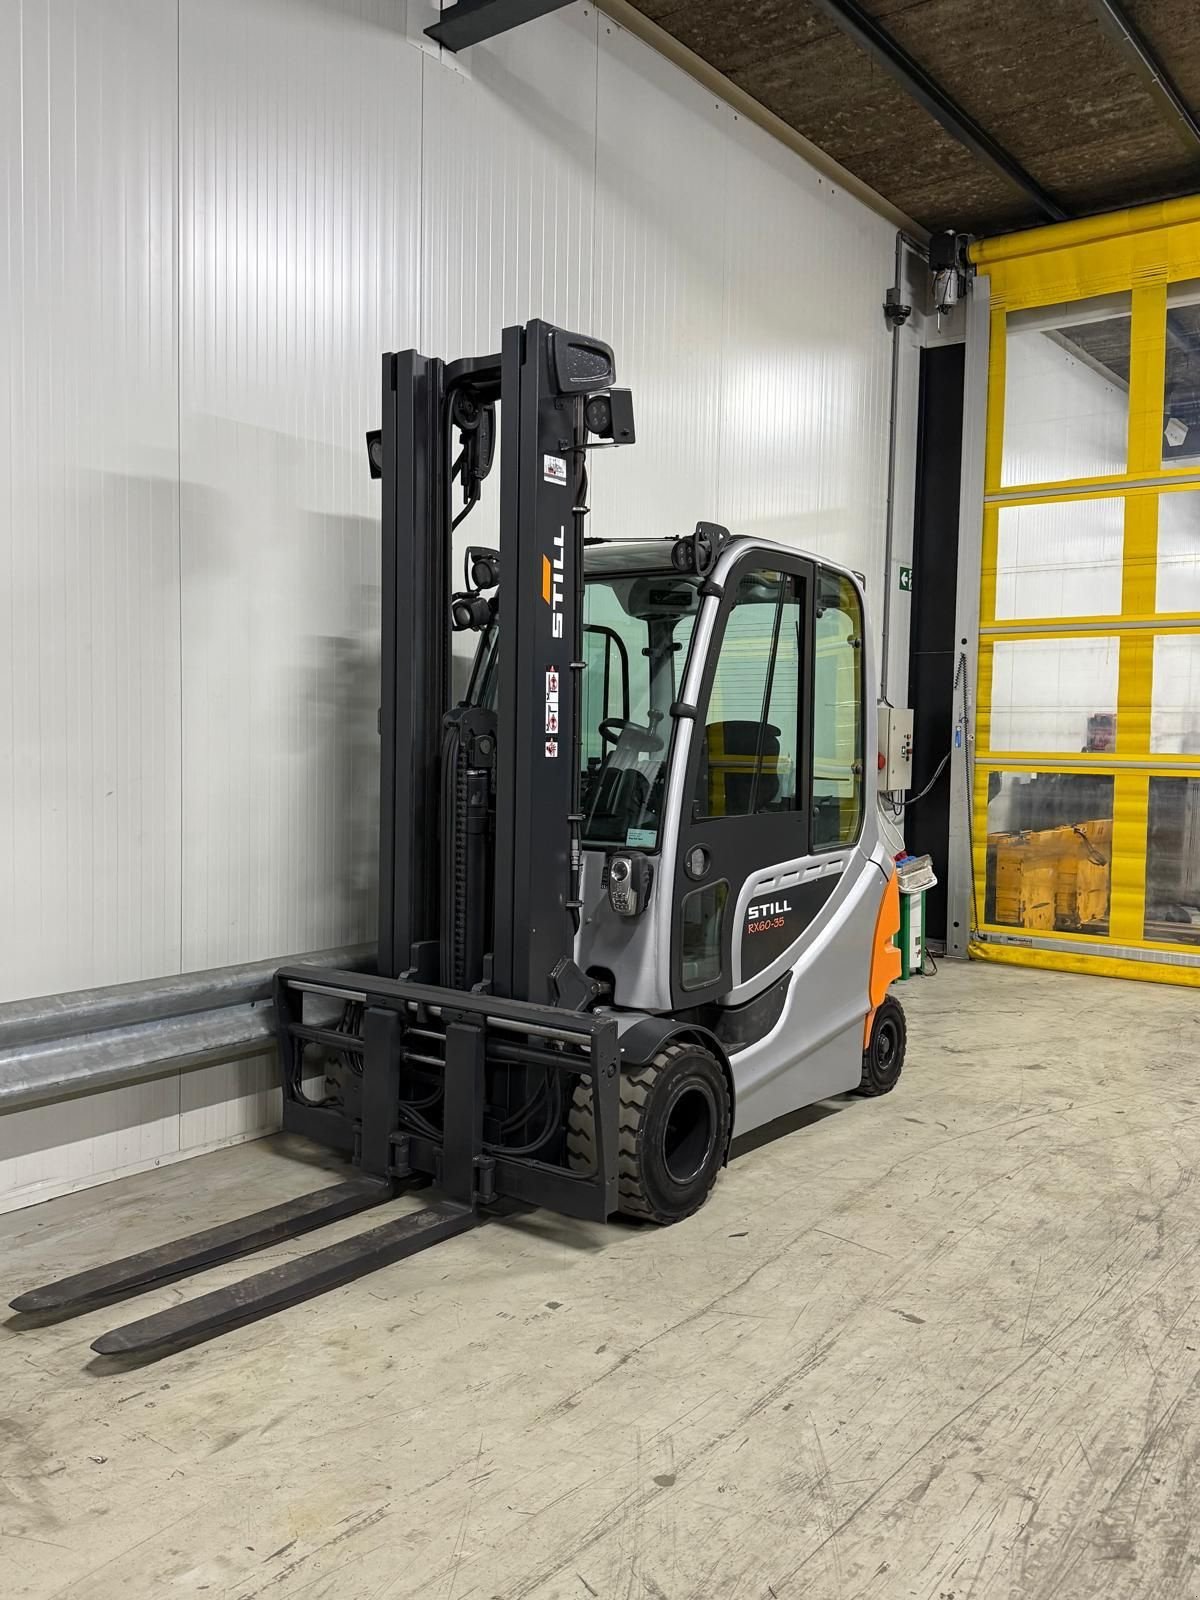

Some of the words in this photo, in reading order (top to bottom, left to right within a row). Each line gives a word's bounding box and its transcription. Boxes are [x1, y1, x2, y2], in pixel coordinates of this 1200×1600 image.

[552, 525, 564, 639] STILL
[748, 900, 792, 920] STILL
[748, 916, 785, 934] RX60-35
